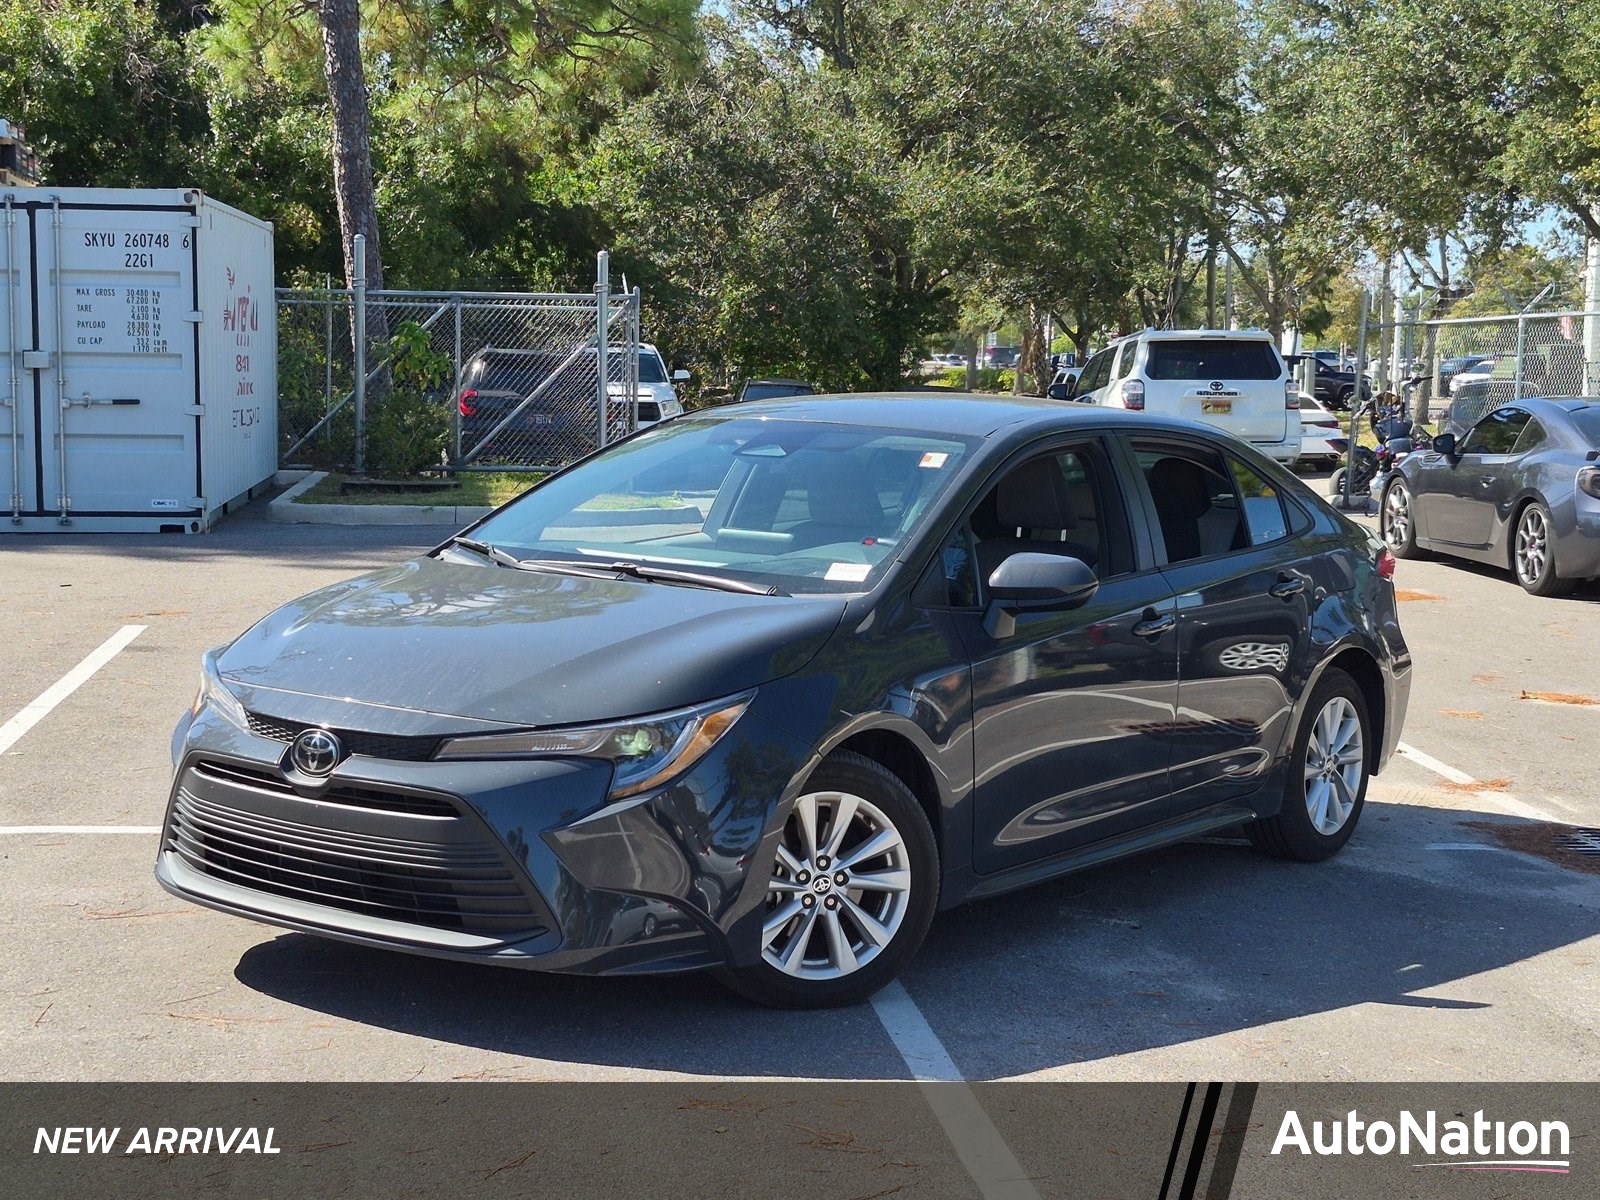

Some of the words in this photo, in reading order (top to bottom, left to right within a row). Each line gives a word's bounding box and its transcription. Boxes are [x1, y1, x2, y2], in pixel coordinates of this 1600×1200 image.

[84, 232, 116, 248] SKYU
[124, 233, 170, 248] 260748
[182, 234, 190, 248] 6
[125, 253, 153, 268] 22G1
[76, 288, 90, 296] MAX
[95, 288, 116, 297] GROSS
[152, 290, 160, 298] kg
[77, 304, 92, 312] TARE
[152, 306, 160, 315] kg
[77, 320, 106, 329] PAYLOAD
[153, 322, 161, 331] kg
